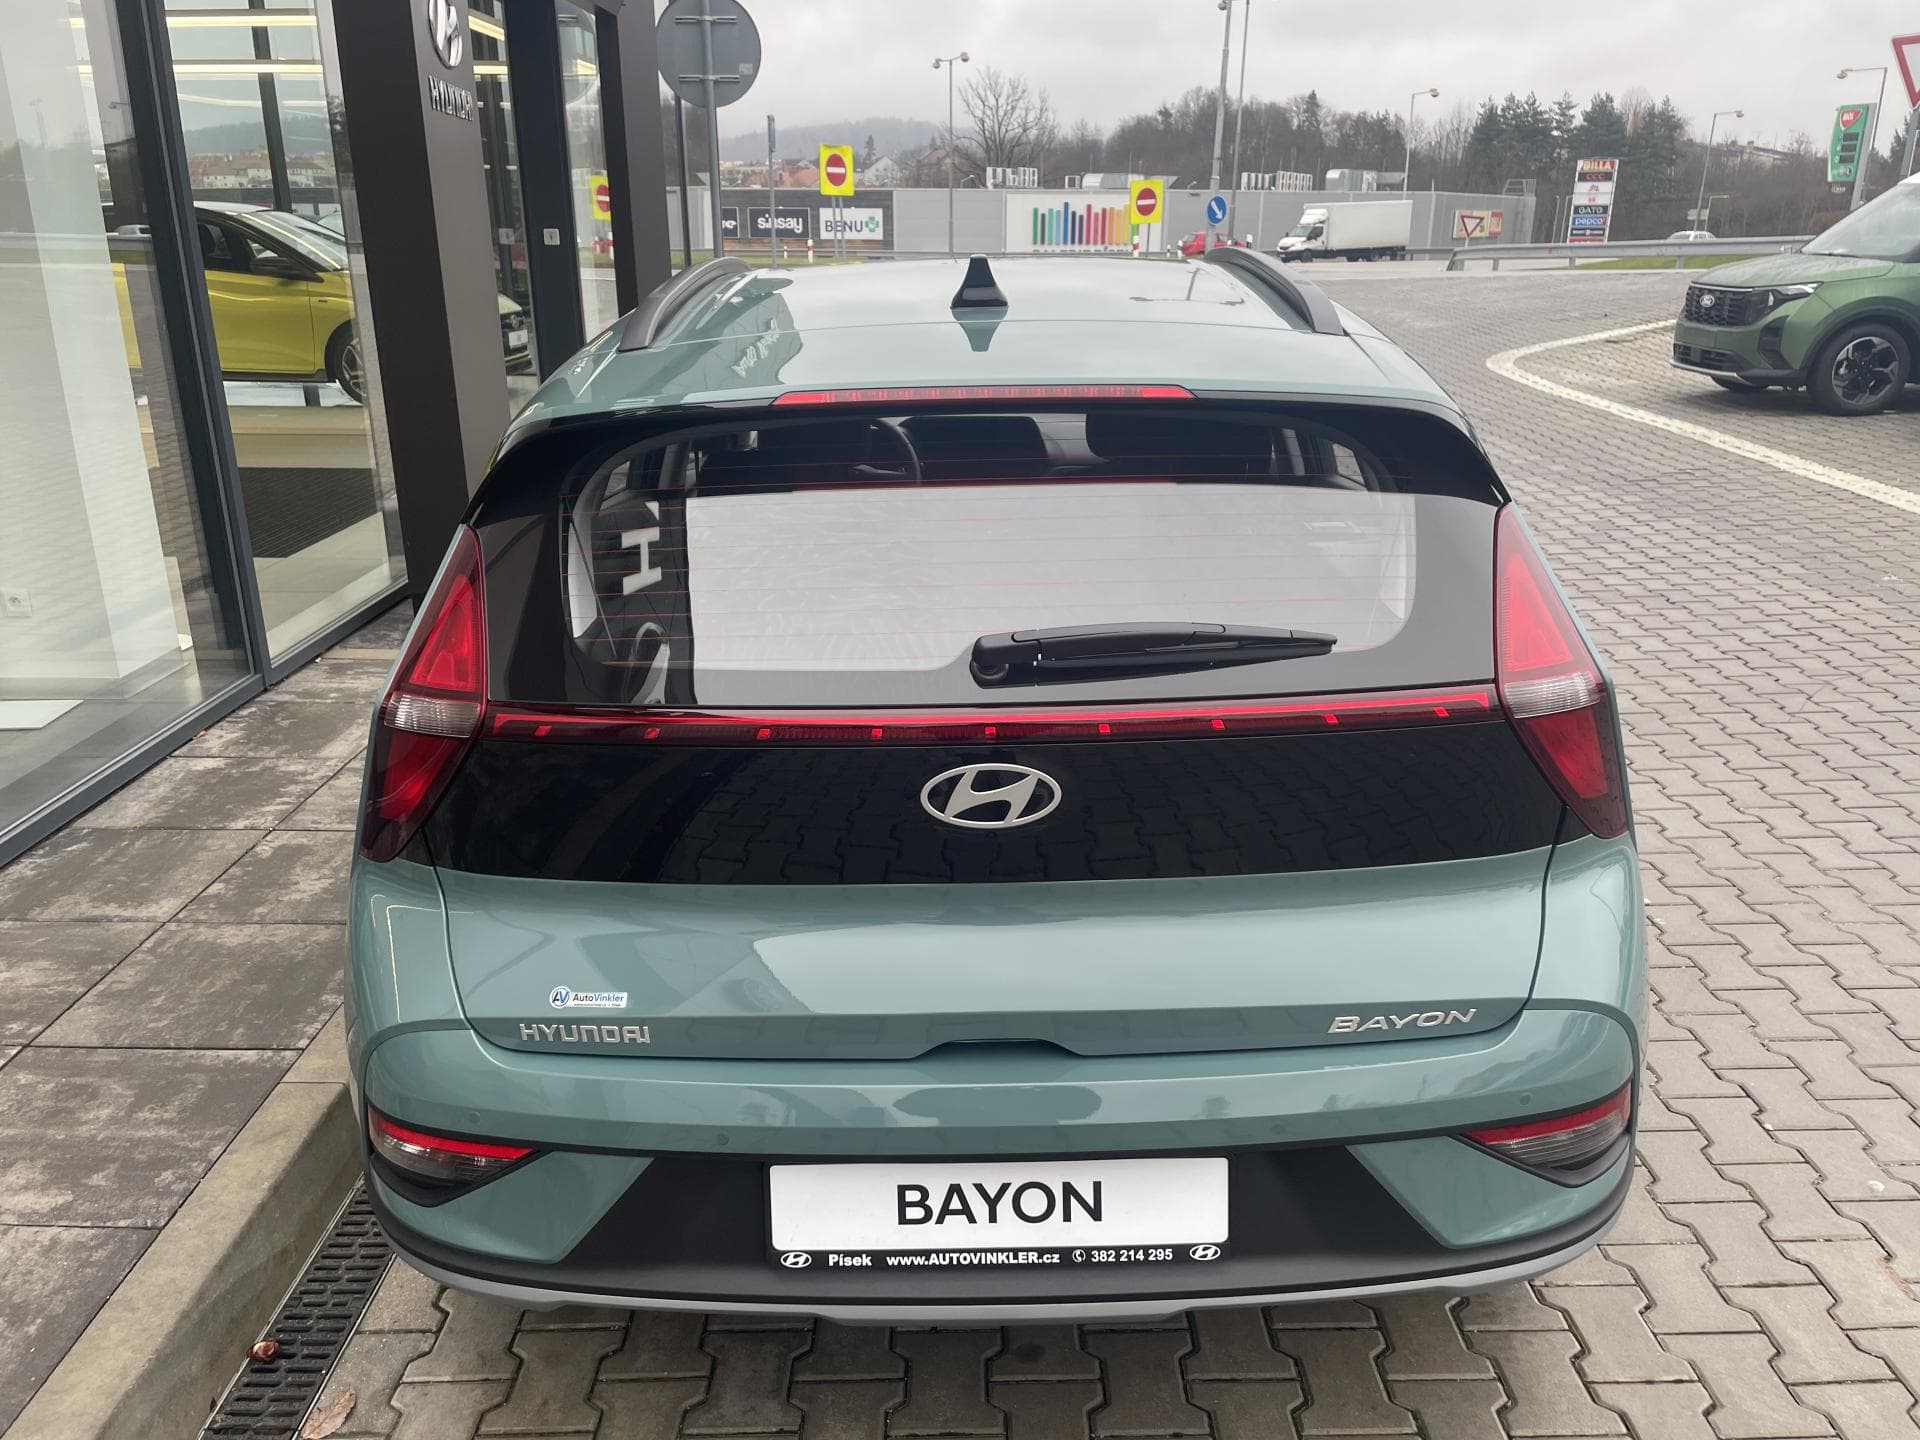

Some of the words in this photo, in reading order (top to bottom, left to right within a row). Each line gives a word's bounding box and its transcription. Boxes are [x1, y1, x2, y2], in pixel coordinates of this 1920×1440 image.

[1578, 206, 1604, 214] GATO
[757, 213, 803, 234] sinsay
[825, 219, 864, 233] BENU
[1574, 216, 1604, 226] pepco
[572, 993, 624, 1002] AutoVinkler
[1327, 1008, 1477, 1034] BAYON
[519, 1023, 651, 1044] HYUNDAI
[896, 1180, 1103, 1226] BAYON
[828, 1253, 873, 1267] Písek
[886, 1251, 1061, 1266] www.AUTOVINKLER.cz
[1091, 1250, 1116, 1262] 382
[1119, 1249, 1145, 1262] 214
[1148, 1248, 1173, 1260] 295
